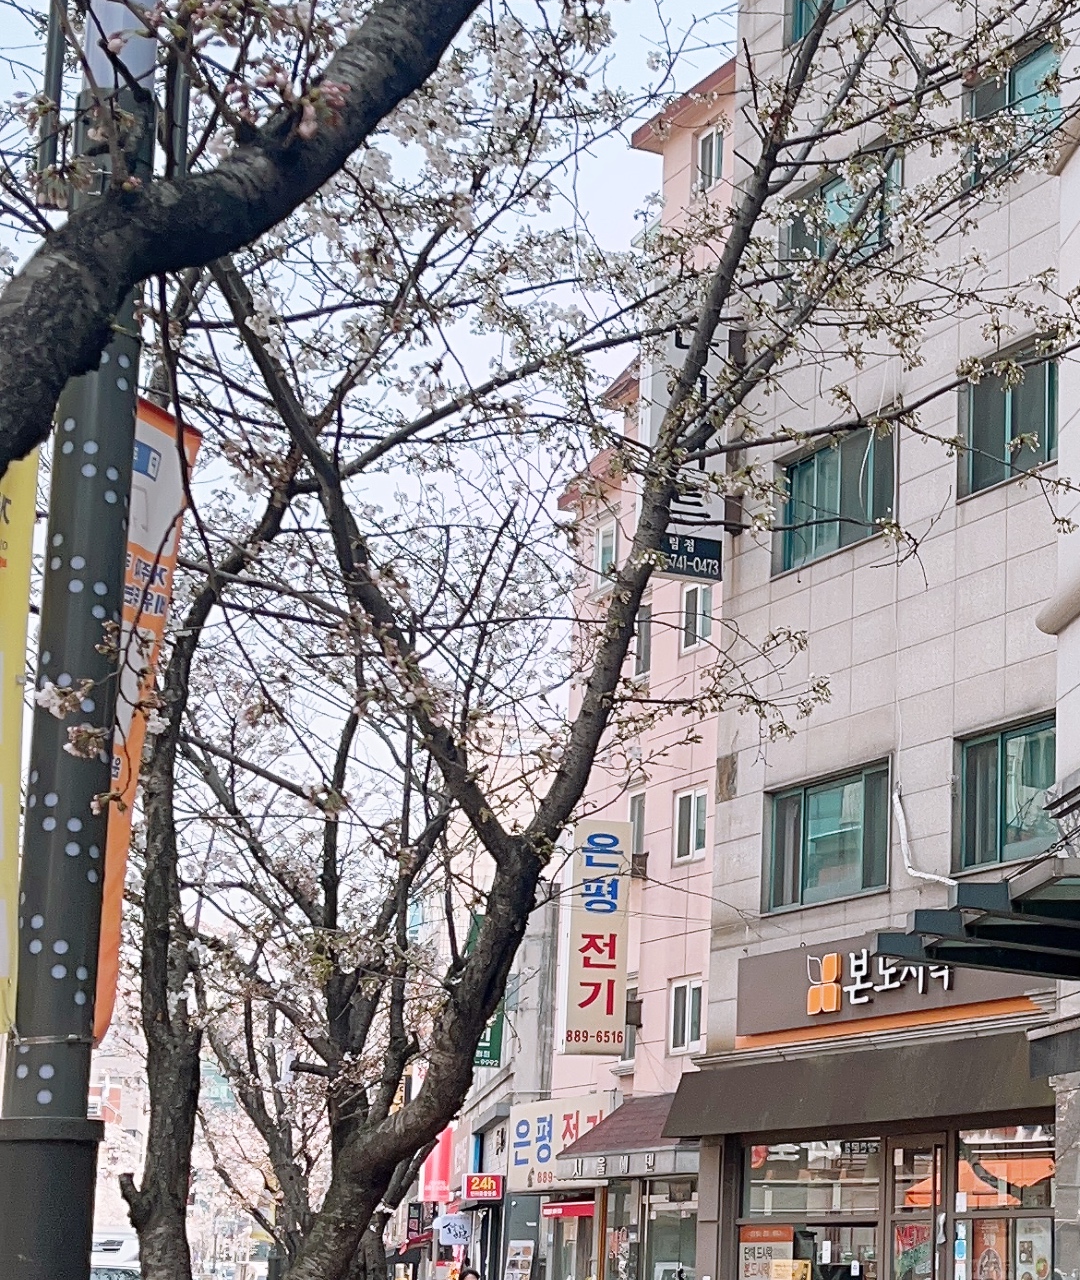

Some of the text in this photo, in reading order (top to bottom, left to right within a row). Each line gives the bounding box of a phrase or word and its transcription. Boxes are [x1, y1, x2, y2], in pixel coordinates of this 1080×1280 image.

[577, 832, 624, 1017] 은평 전기
[566, 1029, 624, 1044] 889-6516
[513, 1113, 553, 1167] 은평
[471, 1176, 497, 1190] 24h
[537, 1170, 577, 1184] 889-
